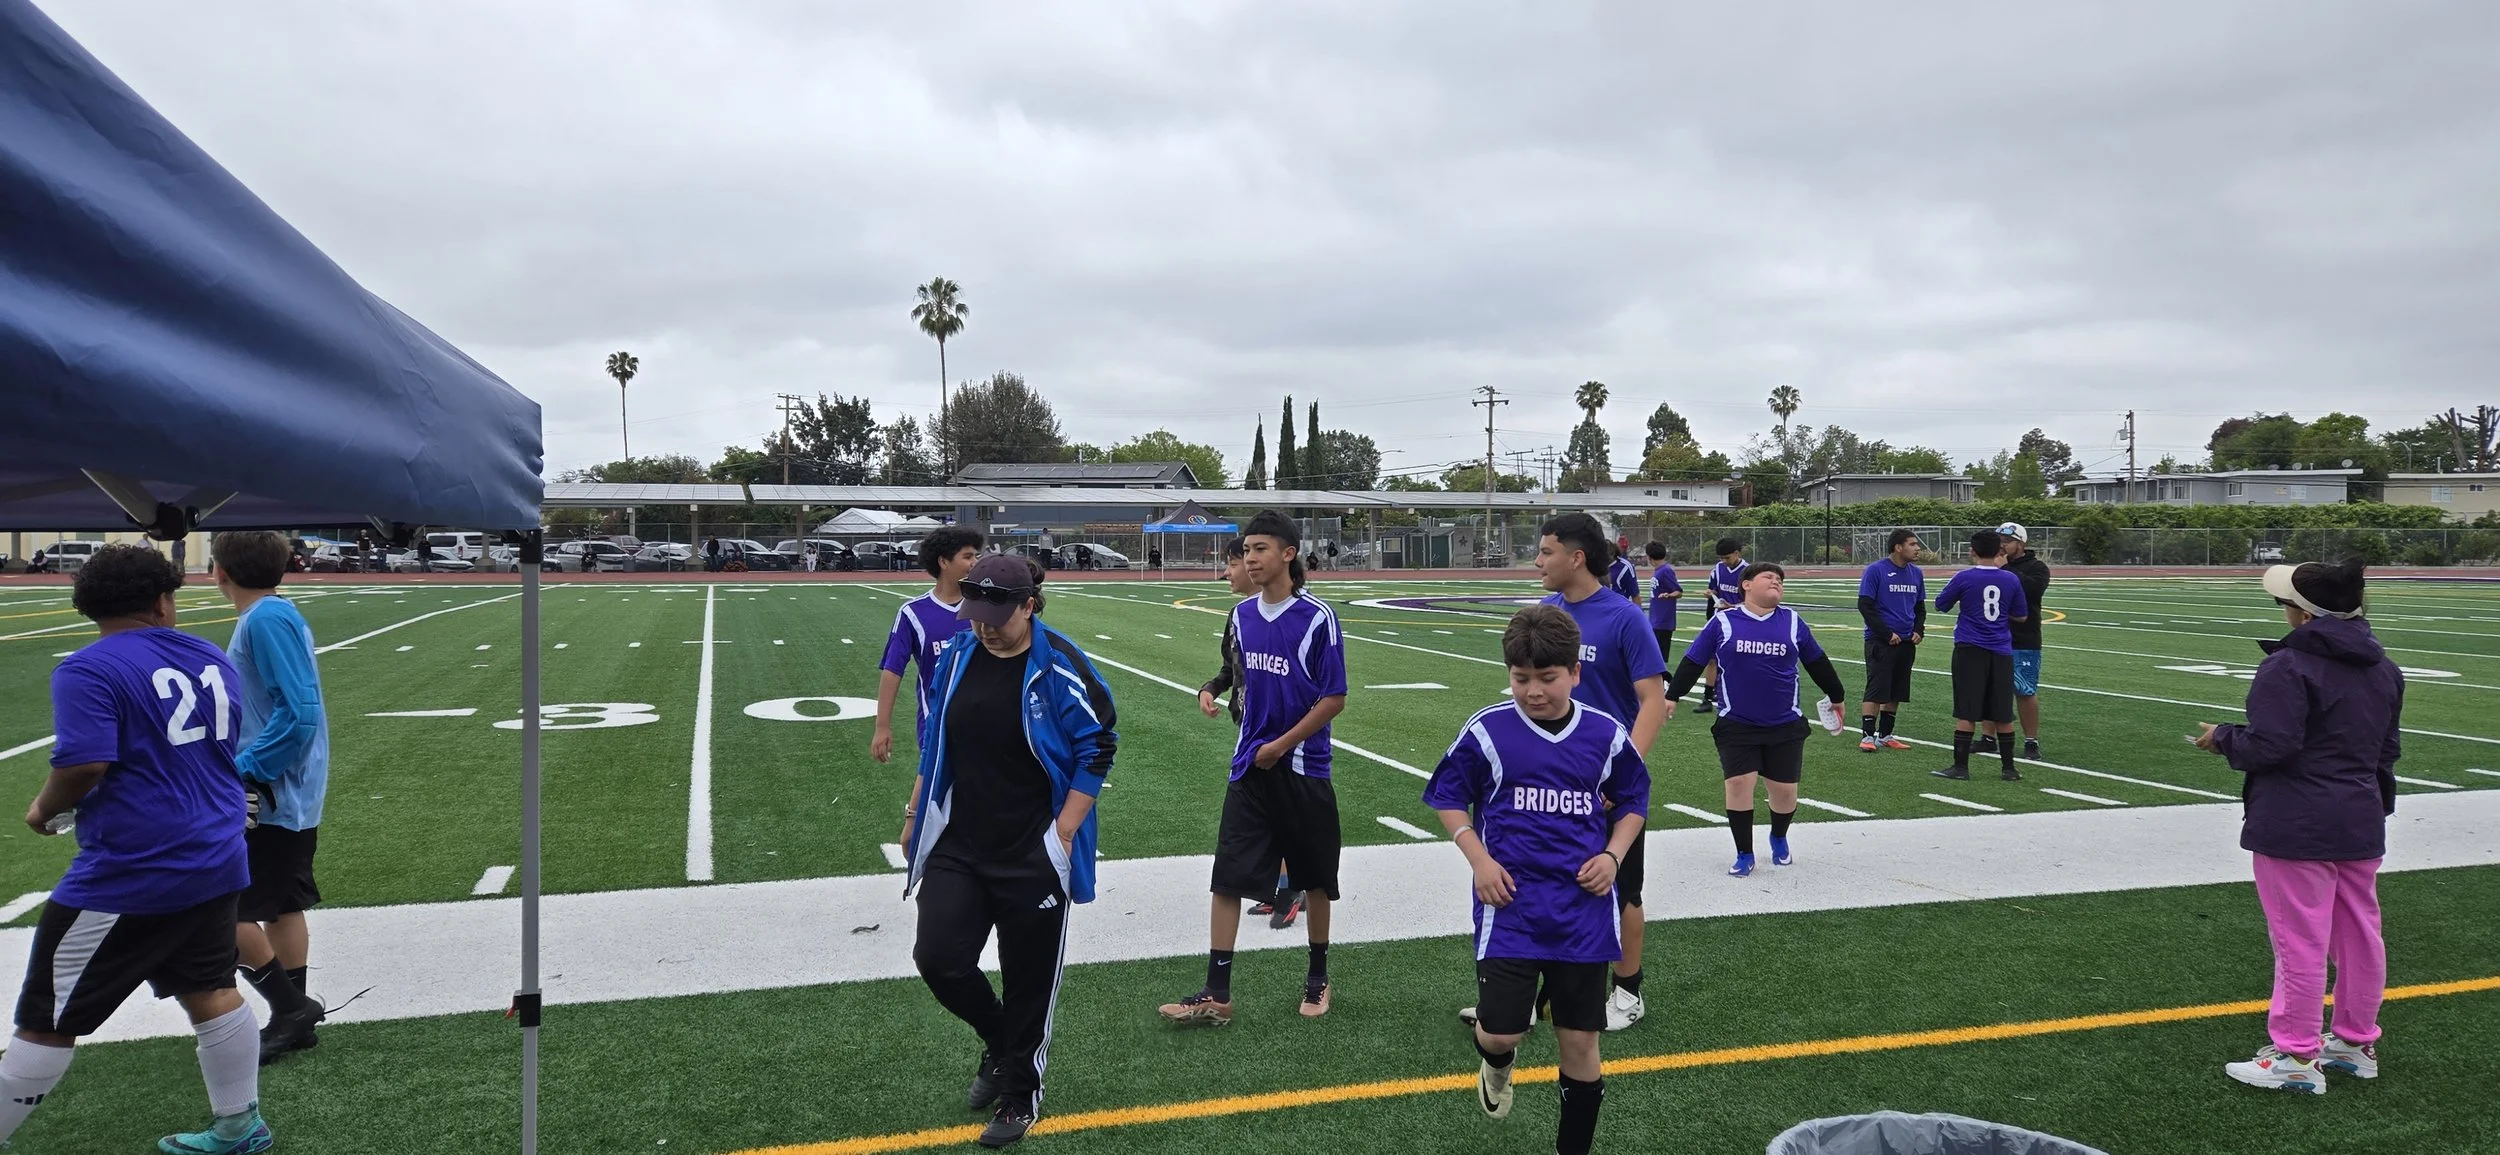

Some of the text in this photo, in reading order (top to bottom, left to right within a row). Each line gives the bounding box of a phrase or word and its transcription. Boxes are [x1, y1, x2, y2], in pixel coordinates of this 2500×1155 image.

[1983, 585, 2001, 622] 8
[1736, 639, 1787, 657] BRIDGES
[152, 664, 230, 746] 21
[1513, 786, 1594, 816] BRIDGES
